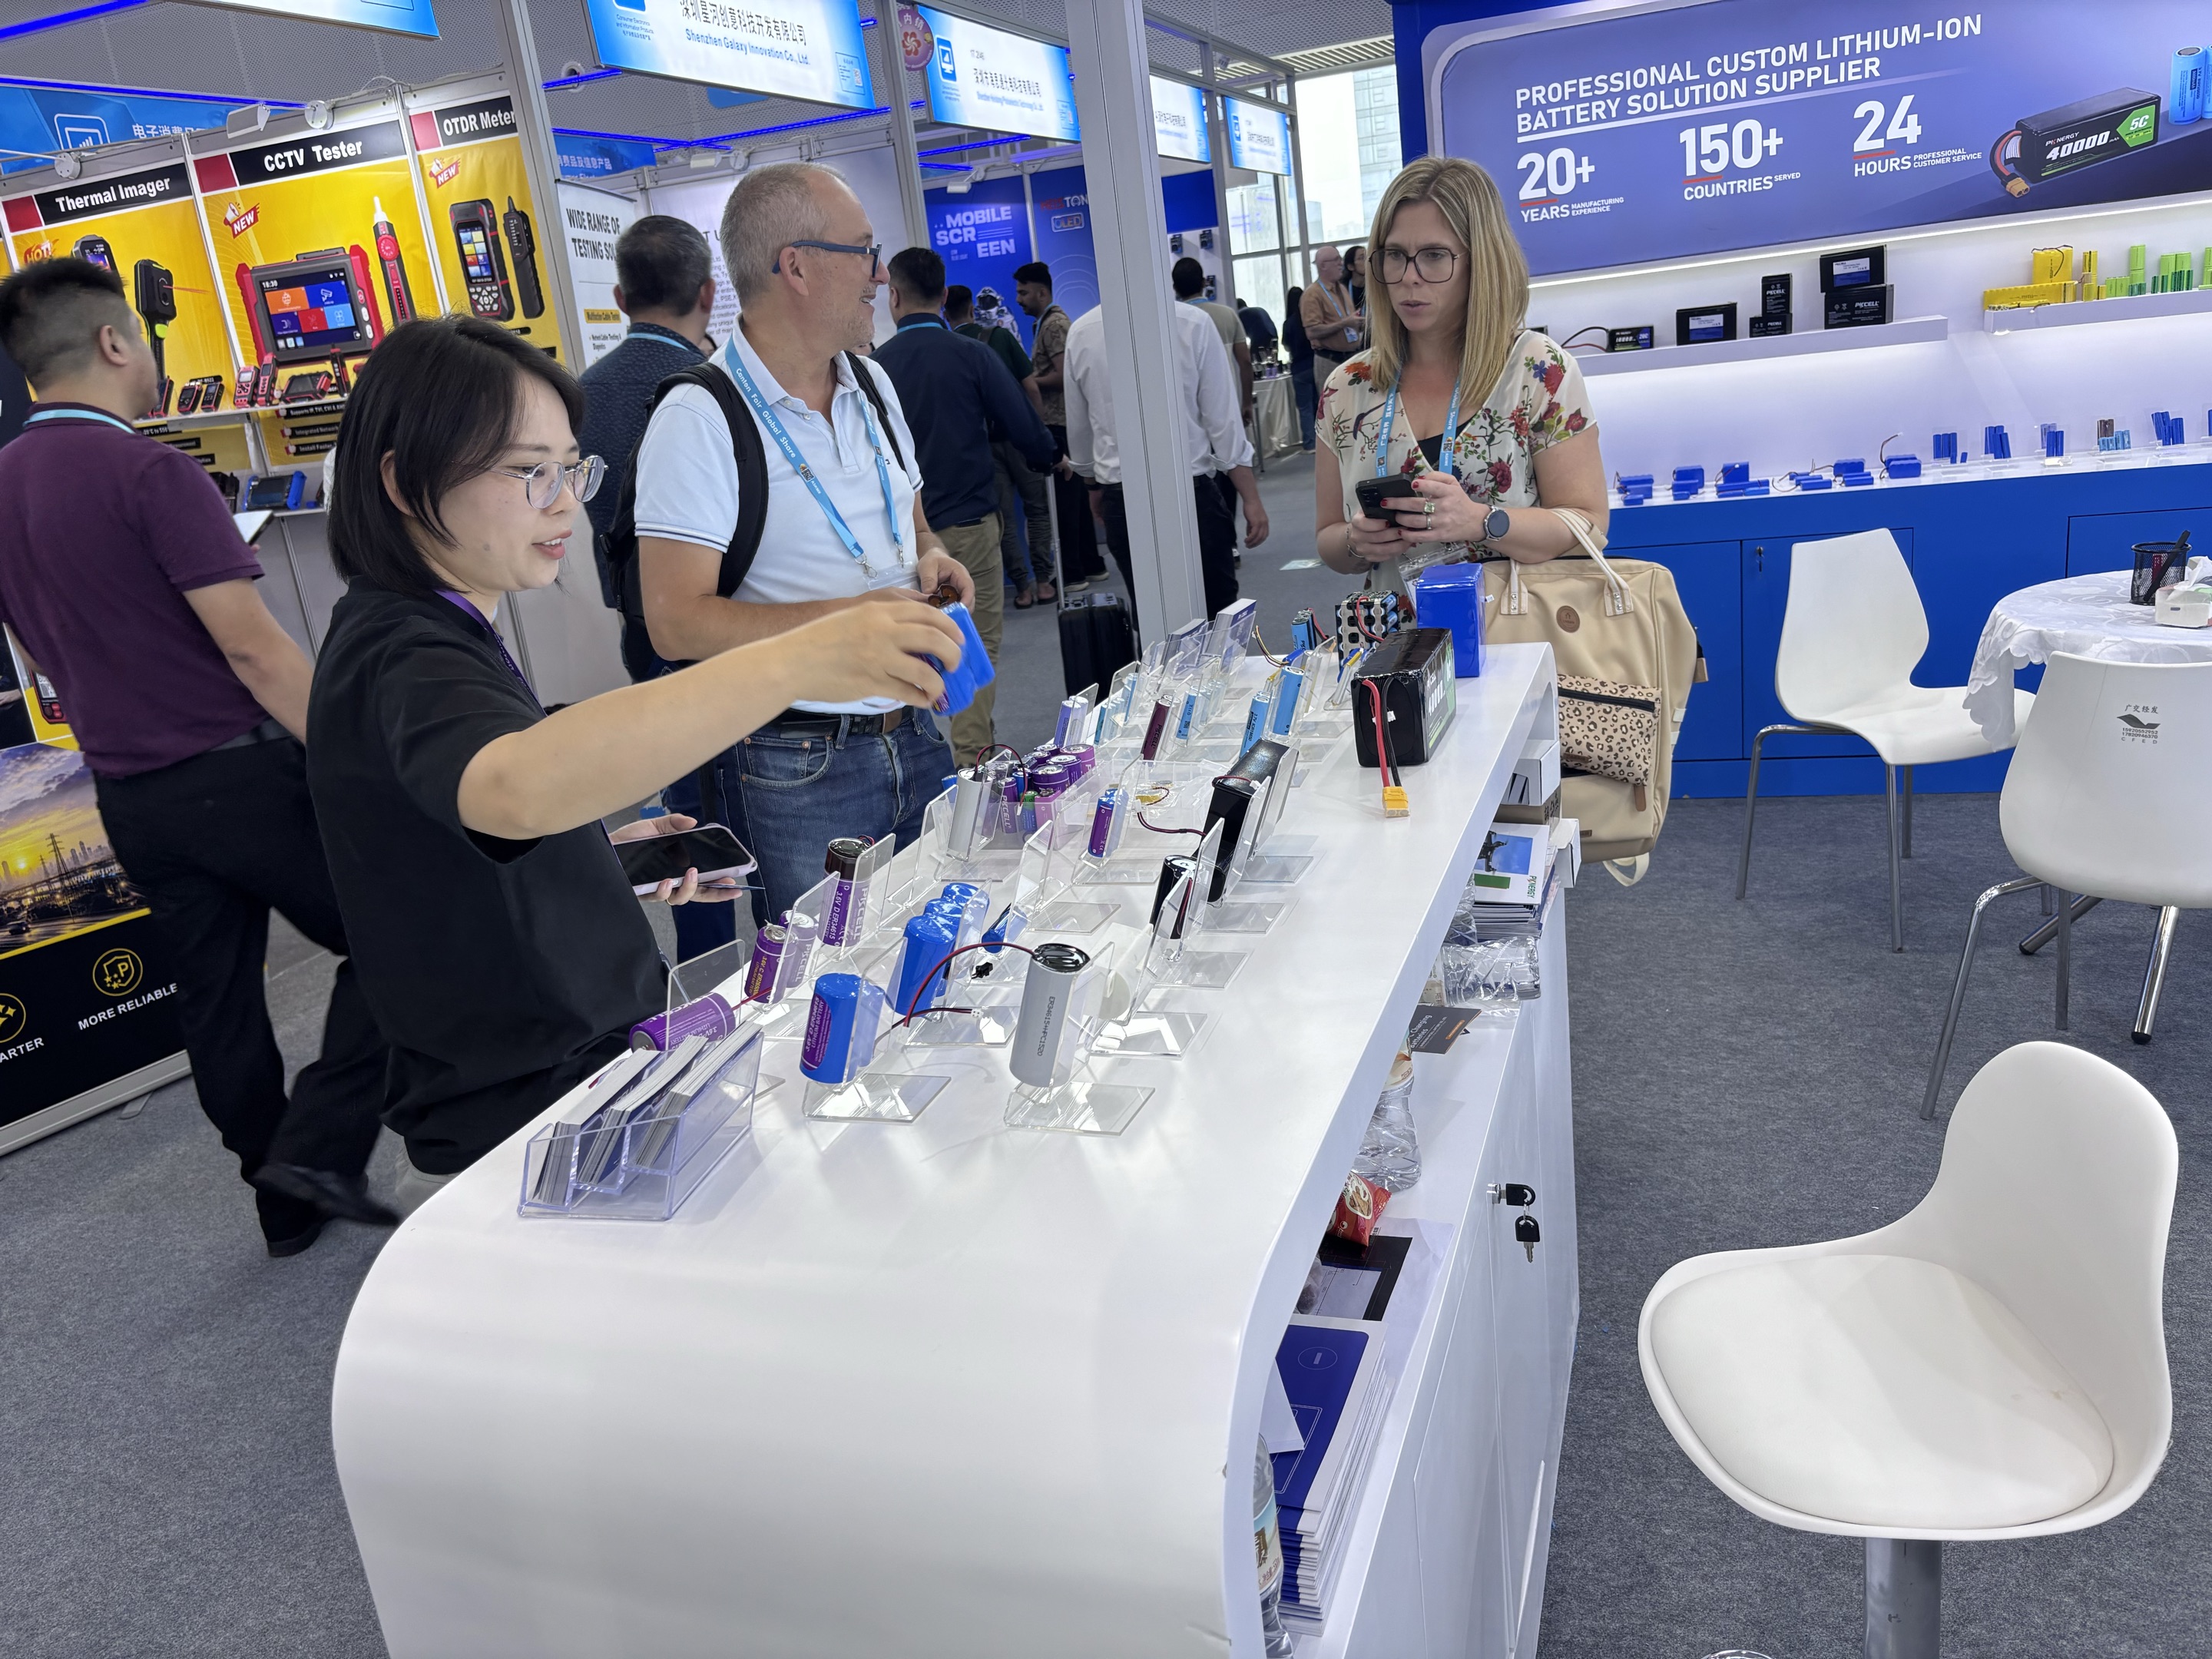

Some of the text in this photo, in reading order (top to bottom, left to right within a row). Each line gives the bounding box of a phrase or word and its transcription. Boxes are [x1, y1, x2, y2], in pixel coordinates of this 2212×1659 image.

[685, 28, 810, 65] Shenzhen Galaxy Innovation Co., Ltd.
[1516, 14, 1982, 108] PROFESSIONAL CUSTOM LITHIUM-ION
[1517, 57, 1881, 134] BATTERY SOLUTION SUPPLIER
[443, 110, 515, 137] OTDR Meter
[1853, 94, 1922, 152] 24
[2130, 114, 2149, 131] 5C
[264, 141, 363, 172] CCTV Tester
[1679, 119, 1783, 177] 150+
[1913, 147, 1966, 161] PROFESSIONAL
[1854, 156, 1912, 177] HOURS
[1913, 152, 1982, 168] CUSTOMER SERVICE
[437, 162, 457, 186] NEW
[1517, 147, 1595, 200] 20+
[1774, 172, 1800, 182] SERVED
[55, 177, 171, 213] Thermal Imager
[1684, 176, 1773, 201] COUNTRIES
[1521, 204, 1570, 223] YEARS
[1571, 197, 1624, 210] MANUFACTURING
[1571, 205, 1611, 217] EXPERIENCE
[233, 210, 255, 235] NEW
[566, 208, 621, 235] WIDE RANGE OF
[945, 206, 1012, 228] MOBILE
[1055, 216, 1081, 229] OLED
[935, 227, 976, 246] SCR
[26, 242, 53, 264] HOT!
[571, 238, 604, 260] TESTING
[976, 239, 1015, 258] EEN
[736, 368, 796, 459] Canton Fair Global Share
[1447, 411, 1456, 430] Share
[1151, 724, 1162, 749] PKCELL
[1001, 795, 1012, 832] PKCELL
[835, 891, 843, 906] 3.6V
[853, 887, 869, 940] PKCELL
[830, 914, 840, 940] ER34615
[795, 944, 812, 982] PKCELL
[78, 983, 178, 1031] MORE RELIABLE
[815, 1002, 824, 1025] BATTERY
[691, 1023, 710, 1035] LITHIUM
[707, 1026, 717, 1038] 3.6V
[1410, 1015, 1432, 1034] Charging
